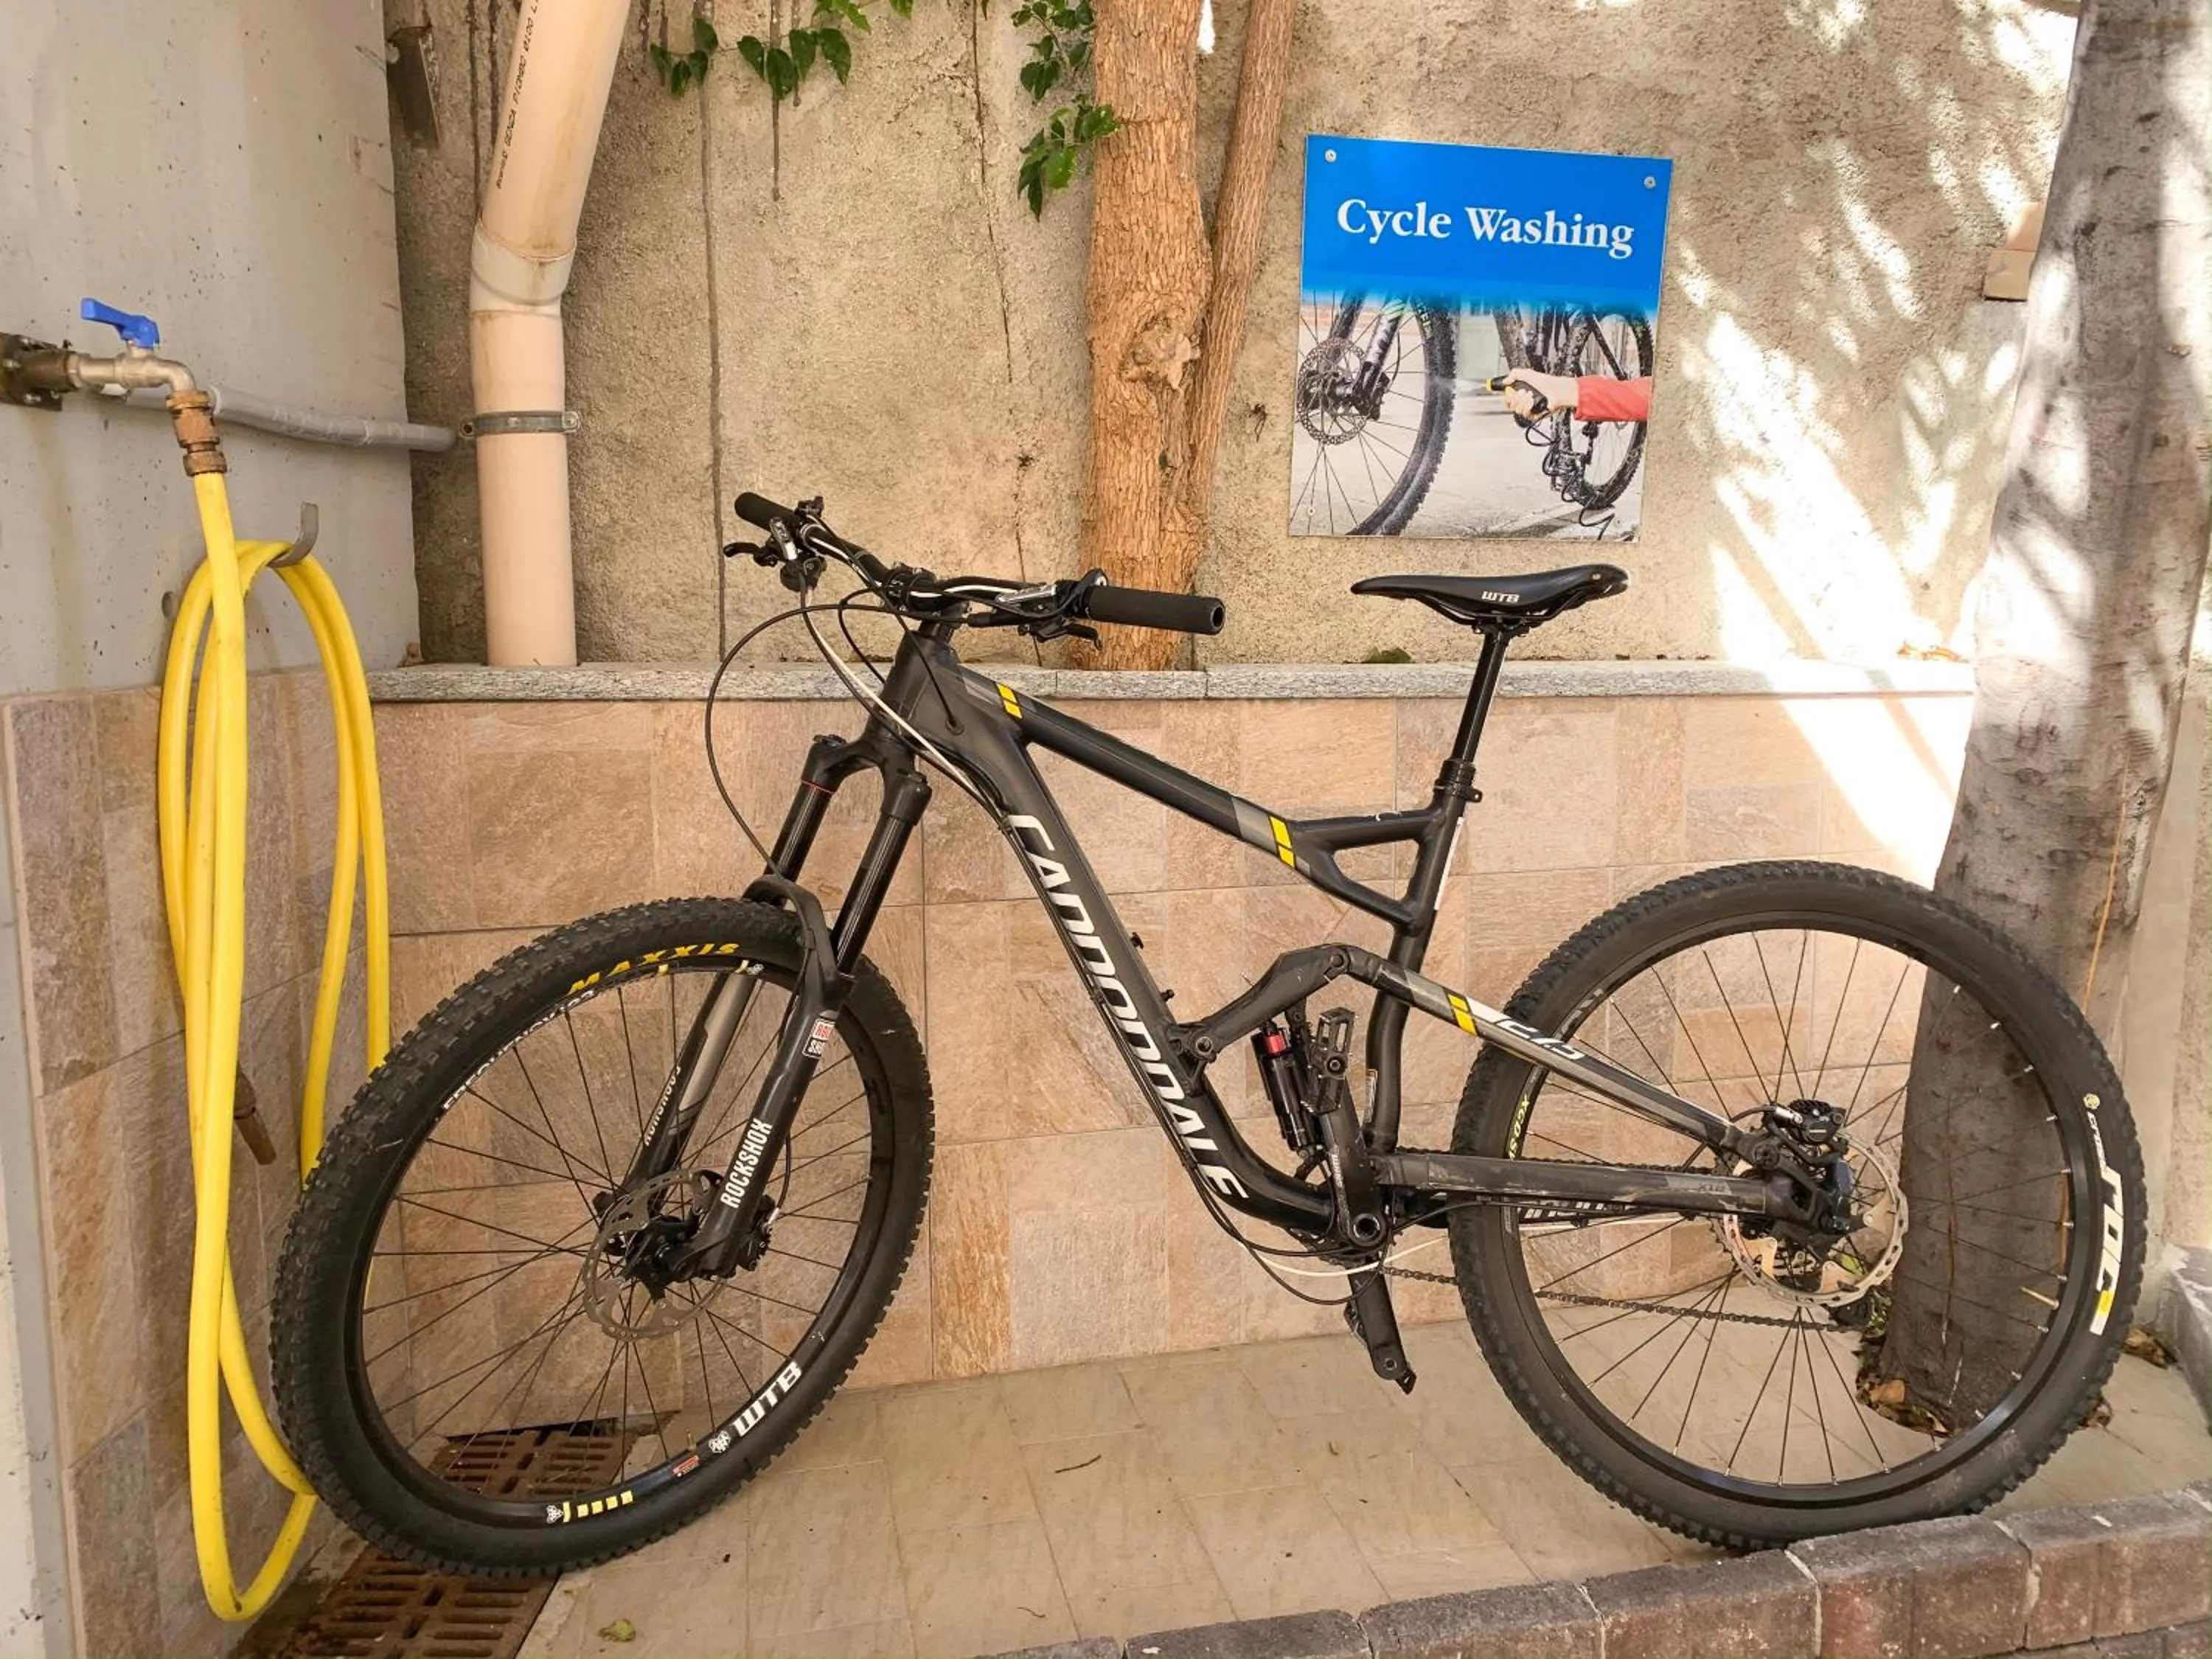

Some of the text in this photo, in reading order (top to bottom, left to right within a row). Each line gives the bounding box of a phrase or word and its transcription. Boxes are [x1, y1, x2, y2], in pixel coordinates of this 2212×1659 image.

[1337, 198, 1635, 260] Cycle Washing
[1481, 591, 1520, 603] WTB
[568, 943, 740, 995] MAXXIS
[1008, 815, 1249, 1198] CANNONDALE
[720, 1118, 773, 1208] ROCKSHOX
[732, 1360, 803, 1437] WTB
